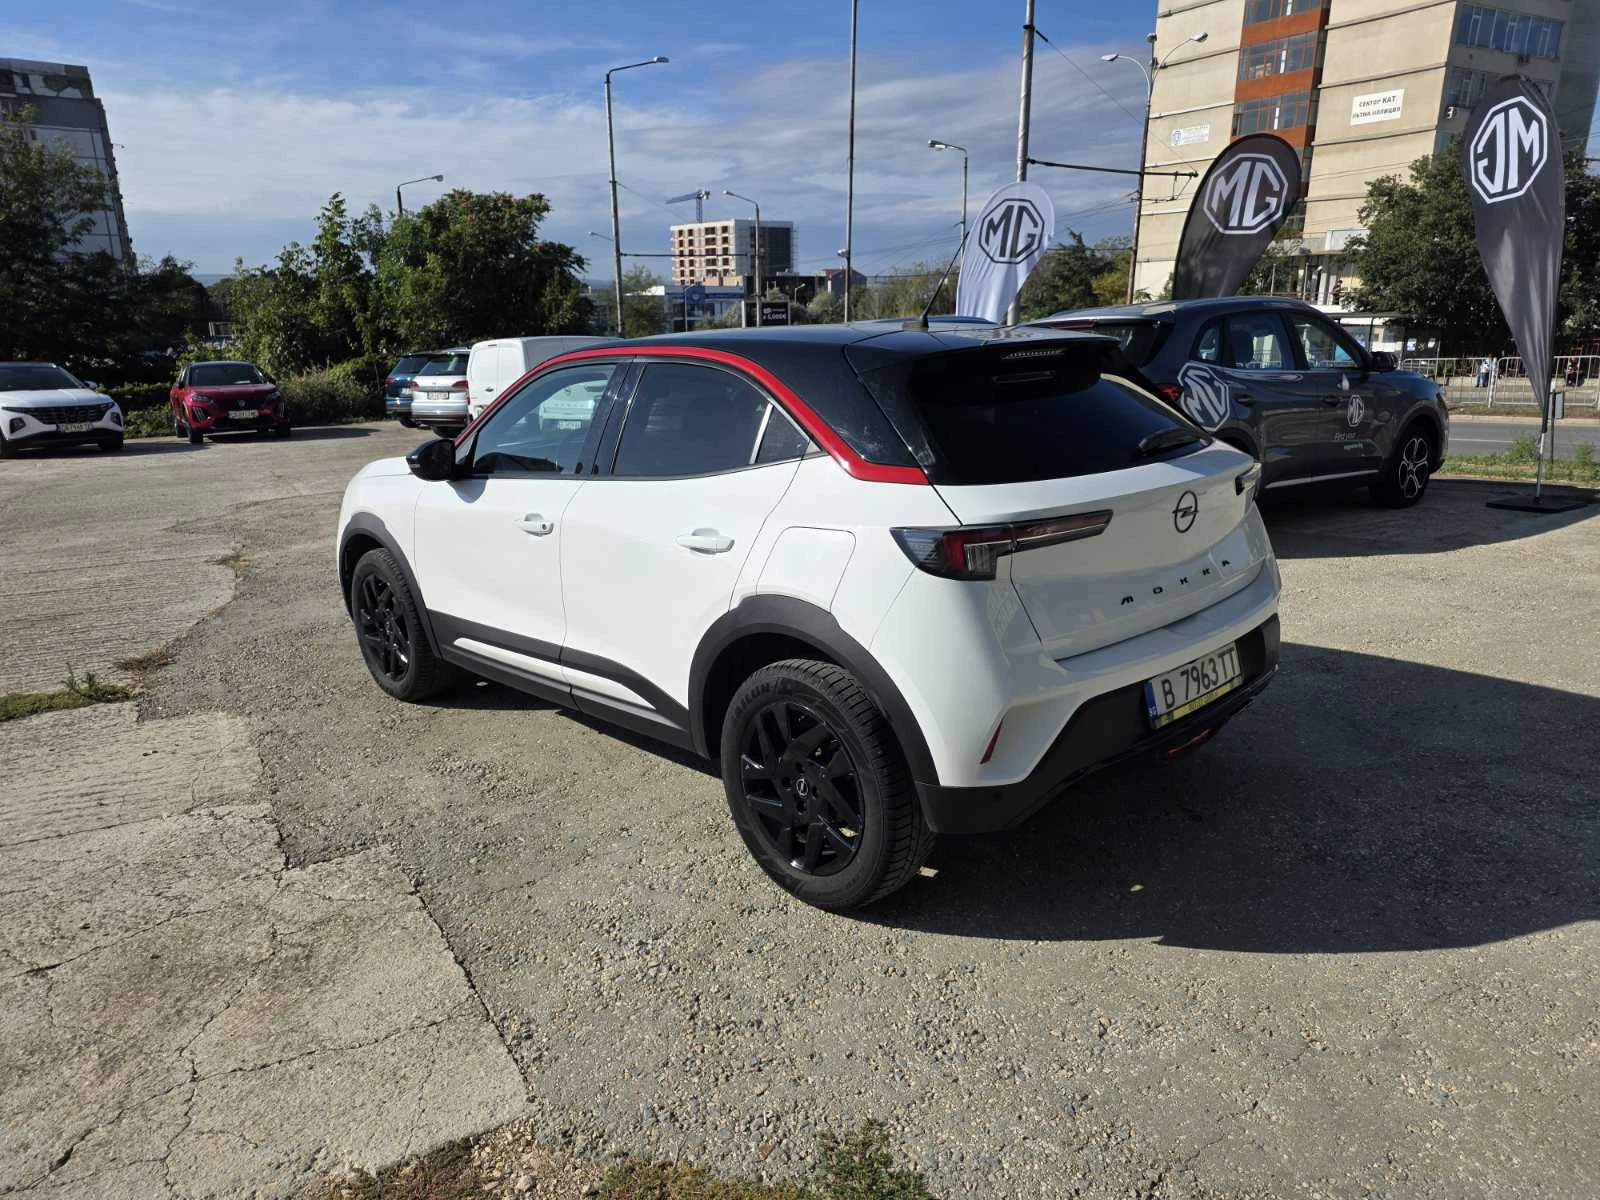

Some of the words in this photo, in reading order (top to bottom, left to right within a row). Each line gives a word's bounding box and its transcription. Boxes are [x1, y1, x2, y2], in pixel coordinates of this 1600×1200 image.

[1382, 95, 1396, 104] КАТ
[1210, 160, 1281, 228] MG
[983, 204, 1040, 259] MG
[1184, 368, 1226, 424] MG
[1121, 560, 1230, 605] MOKKA
[1161, 679, 1175, 710] B
